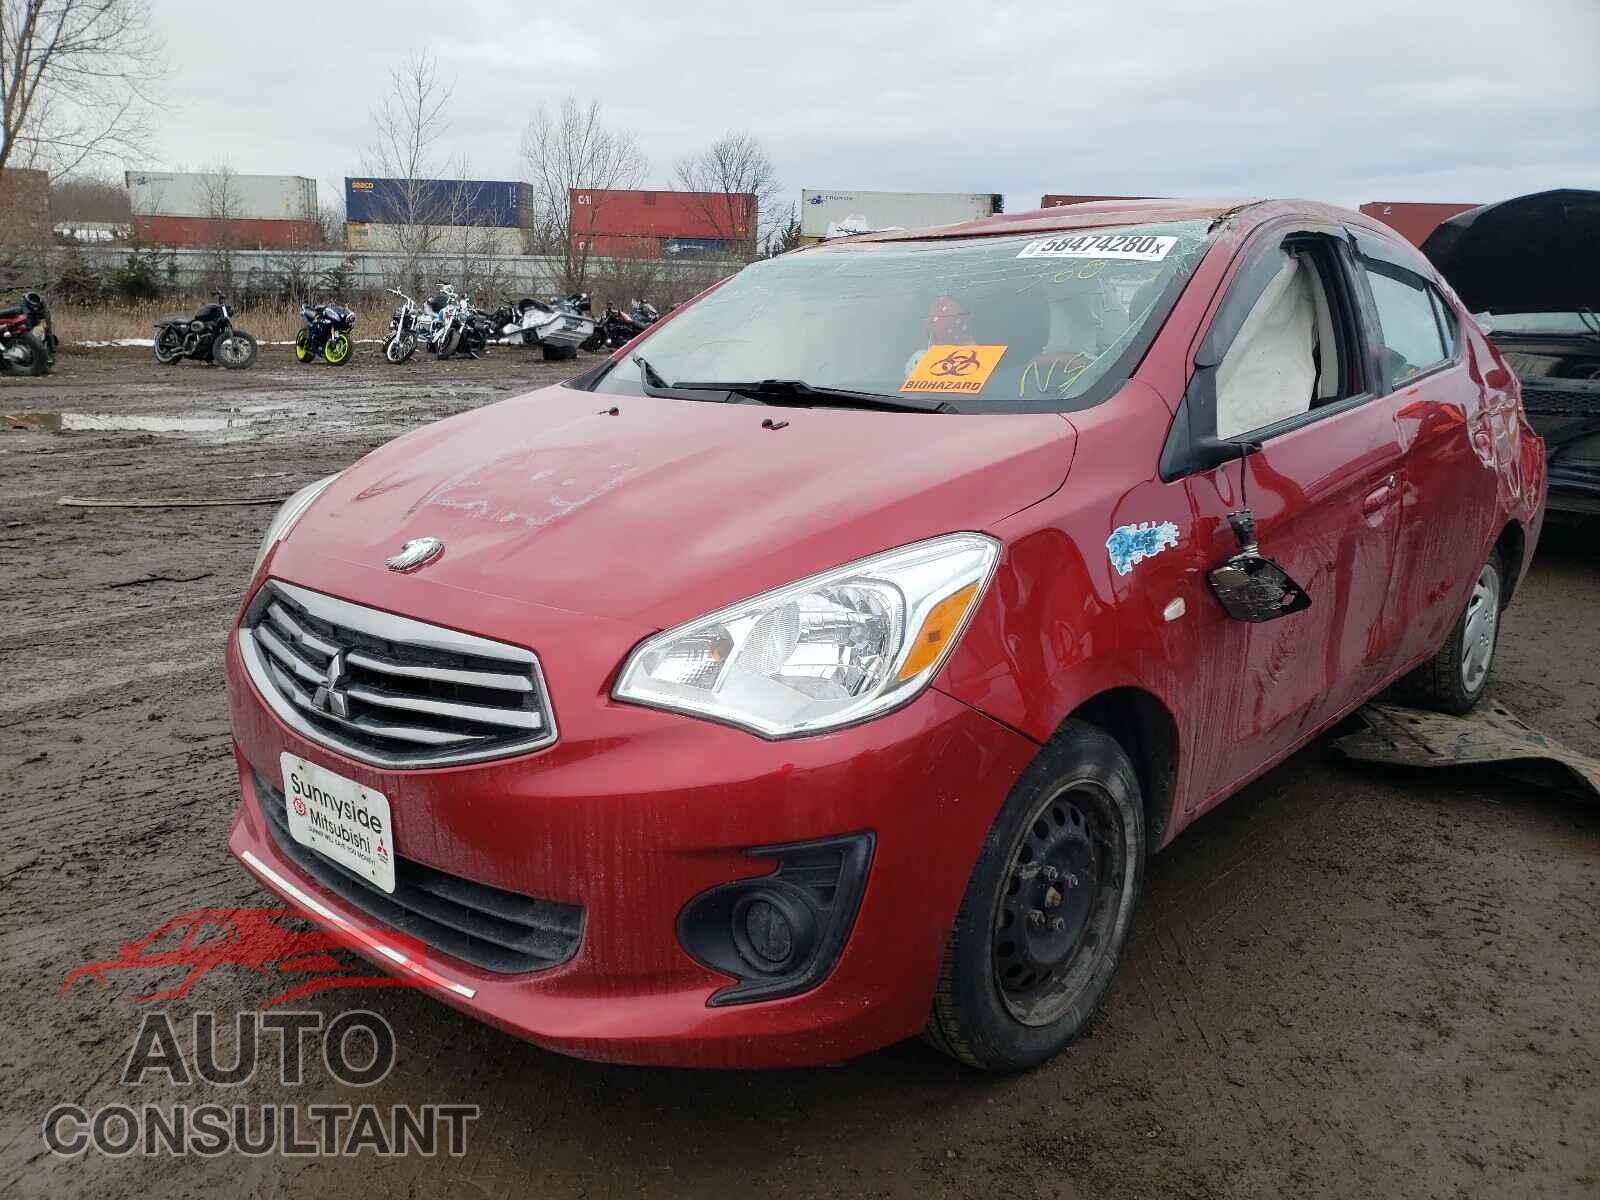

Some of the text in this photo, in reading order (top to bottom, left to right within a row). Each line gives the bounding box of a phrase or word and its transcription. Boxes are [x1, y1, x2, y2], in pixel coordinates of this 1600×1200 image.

[904, 379, 982, 391] BIOHAZARD
[291, 773, 383, 834] Sunnyside
[310, 808, 371, 854] Mitsubishi
